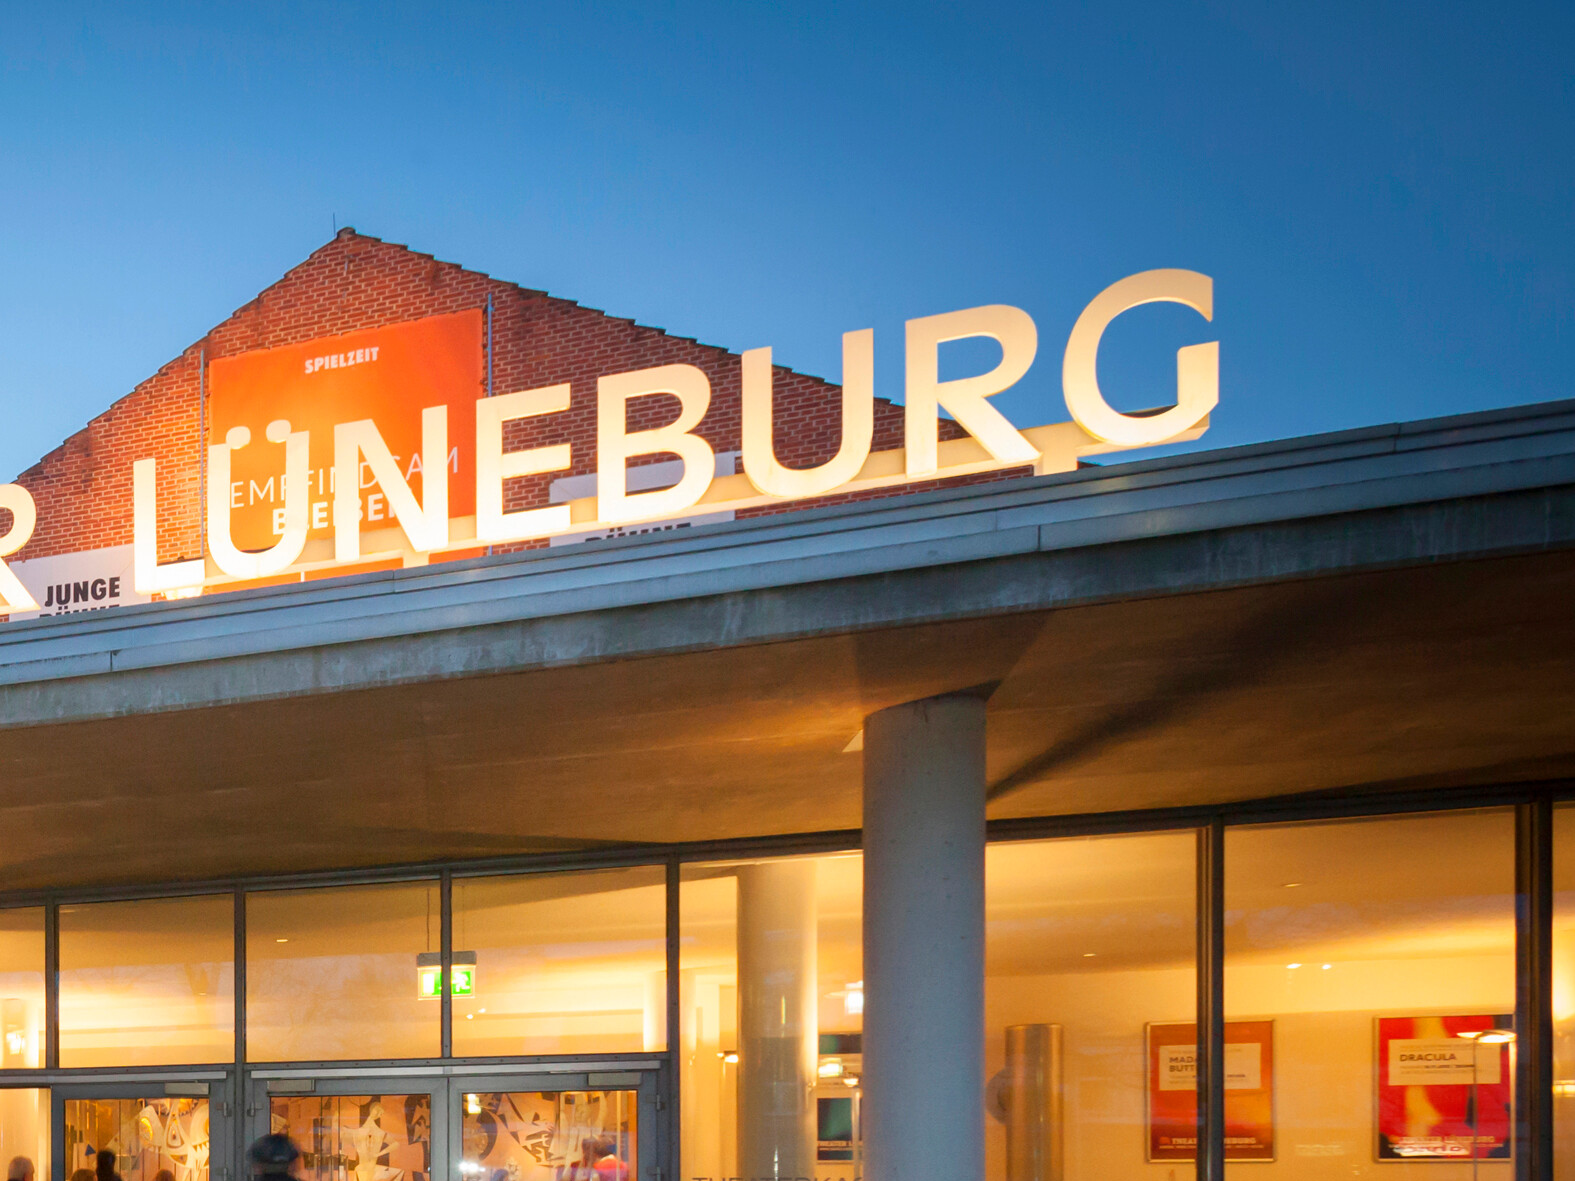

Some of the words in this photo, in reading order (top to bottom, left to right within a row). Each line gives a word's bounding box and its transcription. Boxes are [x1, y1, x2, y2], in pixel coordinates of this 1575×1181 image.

[304, 347, 379, 374] SPIELZEIT
[132, 268, 1219, 594] LÜNEBURG
[44, 576, 121, 607] JUNGE
[1168, 1056, 1197, 1064] MAD
[1399, 1053, 1457, 1062] DRACULA
[1168, 1065, 1196, 1073] BUTT
